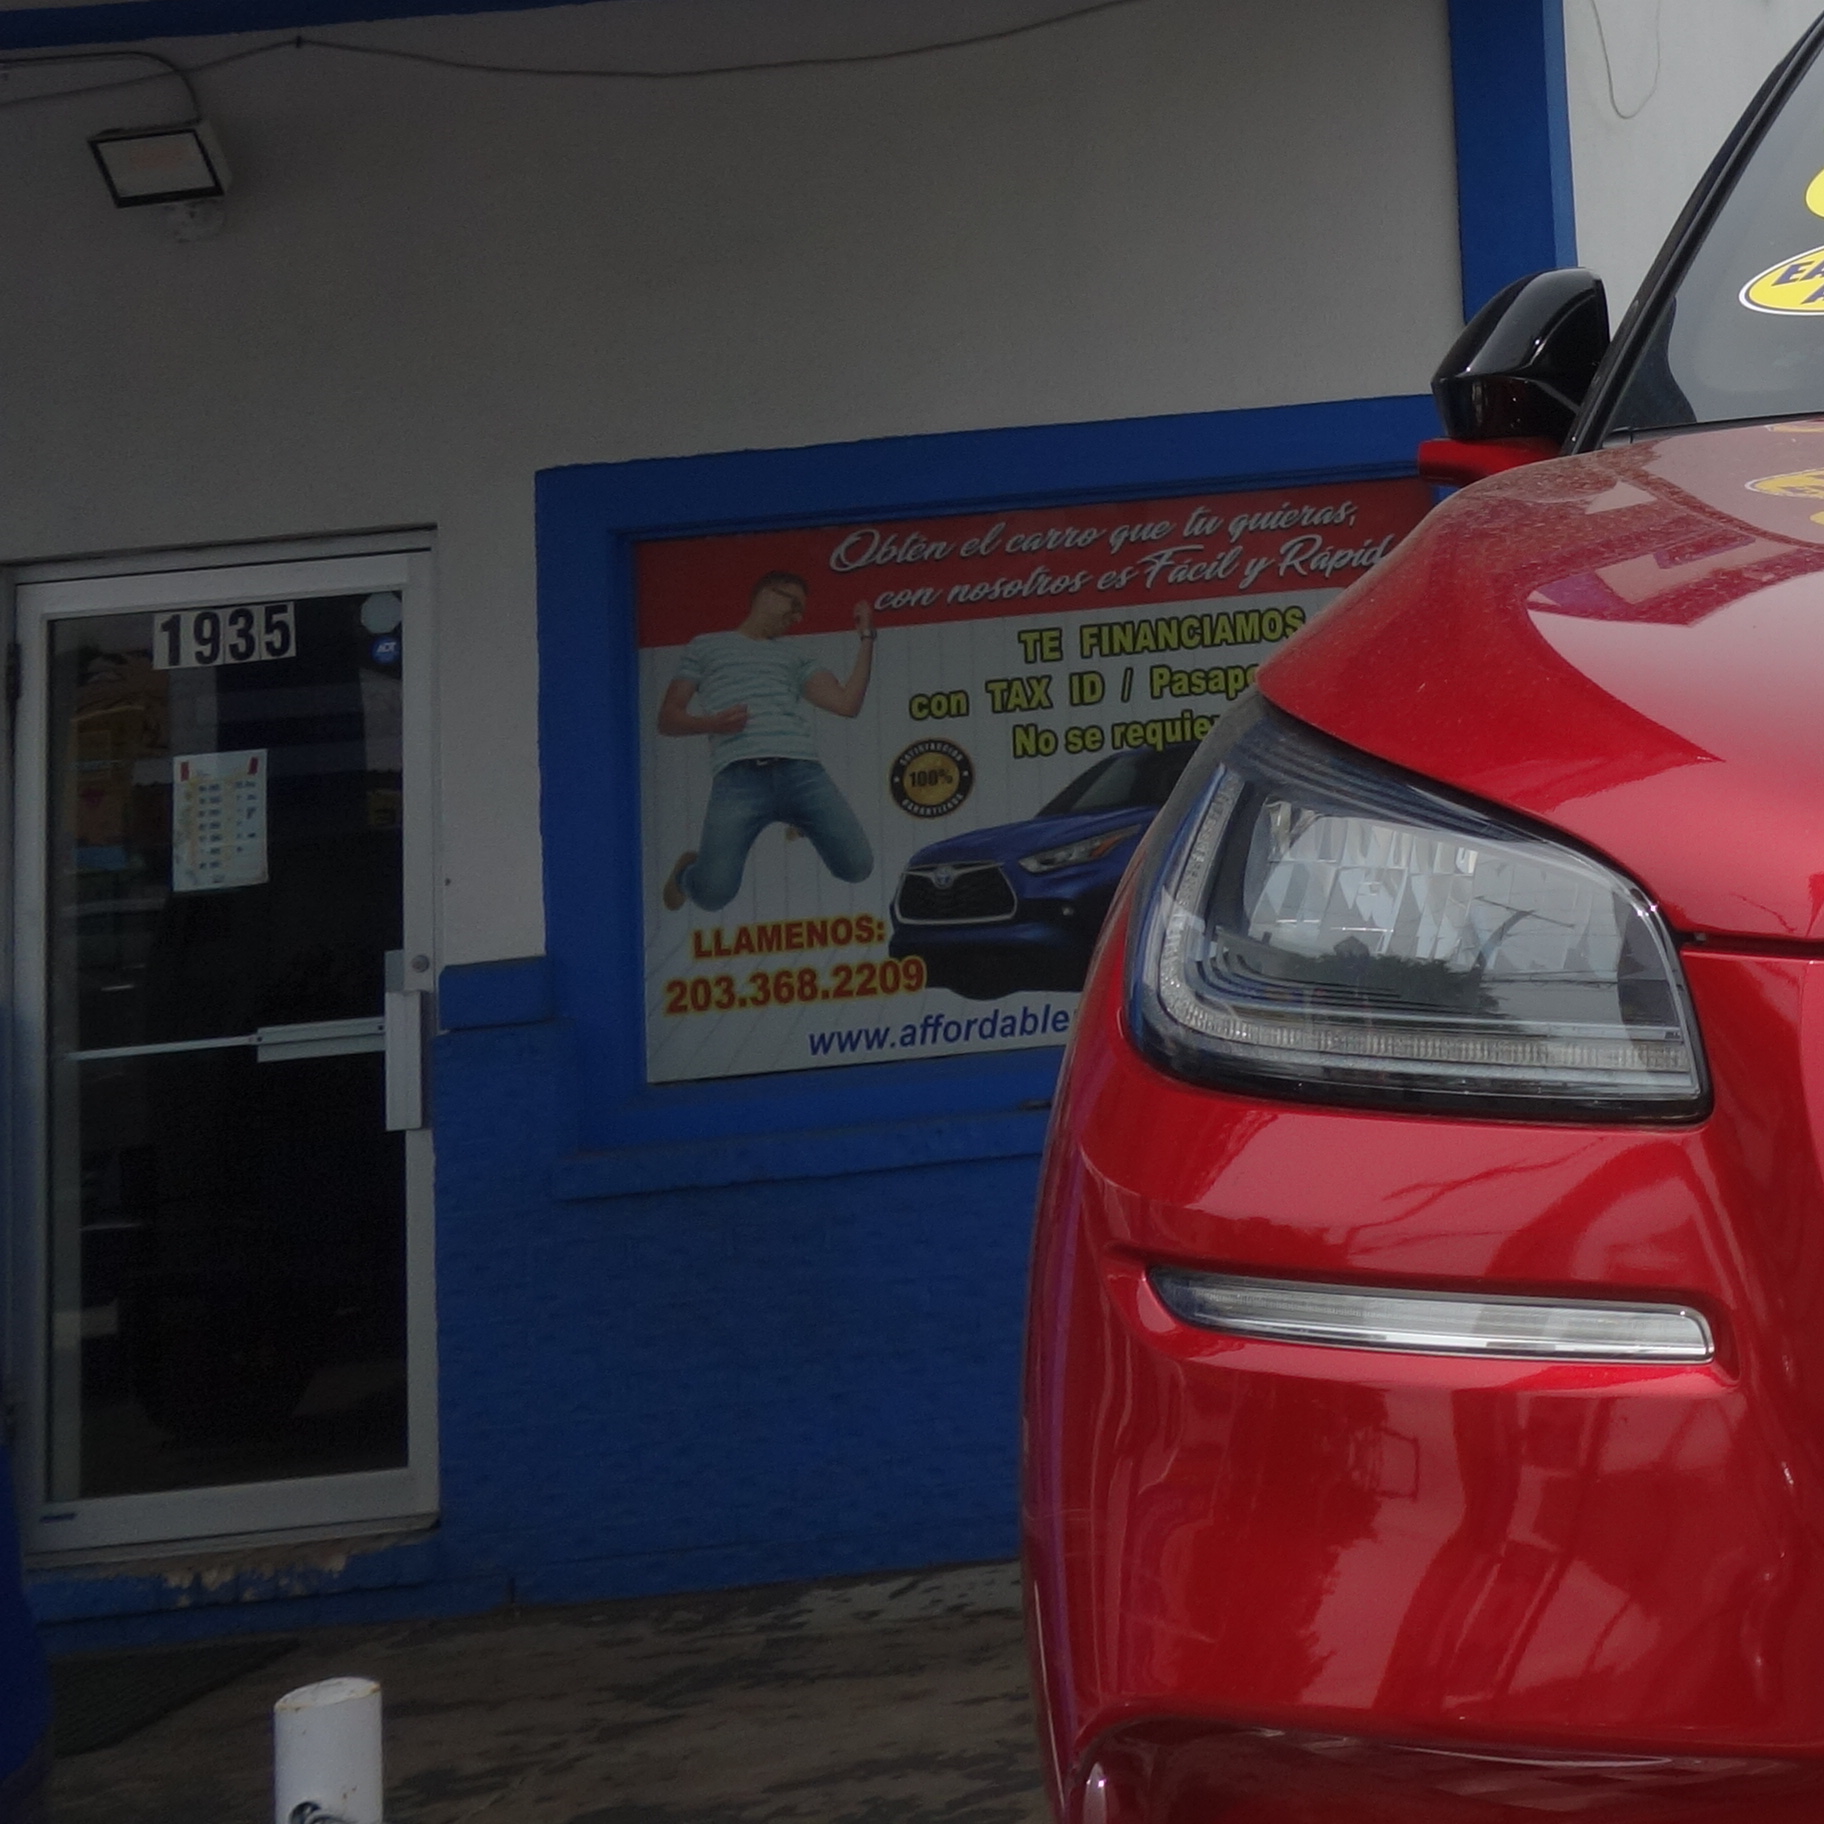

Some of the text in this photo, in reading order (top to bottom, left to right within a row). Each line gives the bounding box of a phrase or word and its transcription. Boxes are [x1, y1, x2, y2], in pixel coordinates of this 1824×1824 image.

[959, 521, 1006, 559] el
[1004, 526, 1107, 555] carro
[1108, 519, 1176, 554] que
[1182, 505, 1224, 538] tu
[873, 585, 942, 611] con
[946, 565, 1094, 604] nosotros
[1096, 564, 1140, 590] es
[1137, 544, 1243, 589] Fácil
[1238, 556, 1275, 590] y
[161, 604, 290, 666] 1935
[1018, 606, 1306, 663] TE FINANCIAMOS
[908, 690, 970, 721] con
[985, 677, 1053, 714] TAX
[1068, 671, 1105, 706] ID
[1011, 709, 1221, 758] No se requie
[908, 768, 954, 788] 100%
[692, 913, 886, 959] LLAMENOS:
[664, 955, 928, 1016] 203.368.2209
[808, 1004, 1076, 1056] www.affordable
